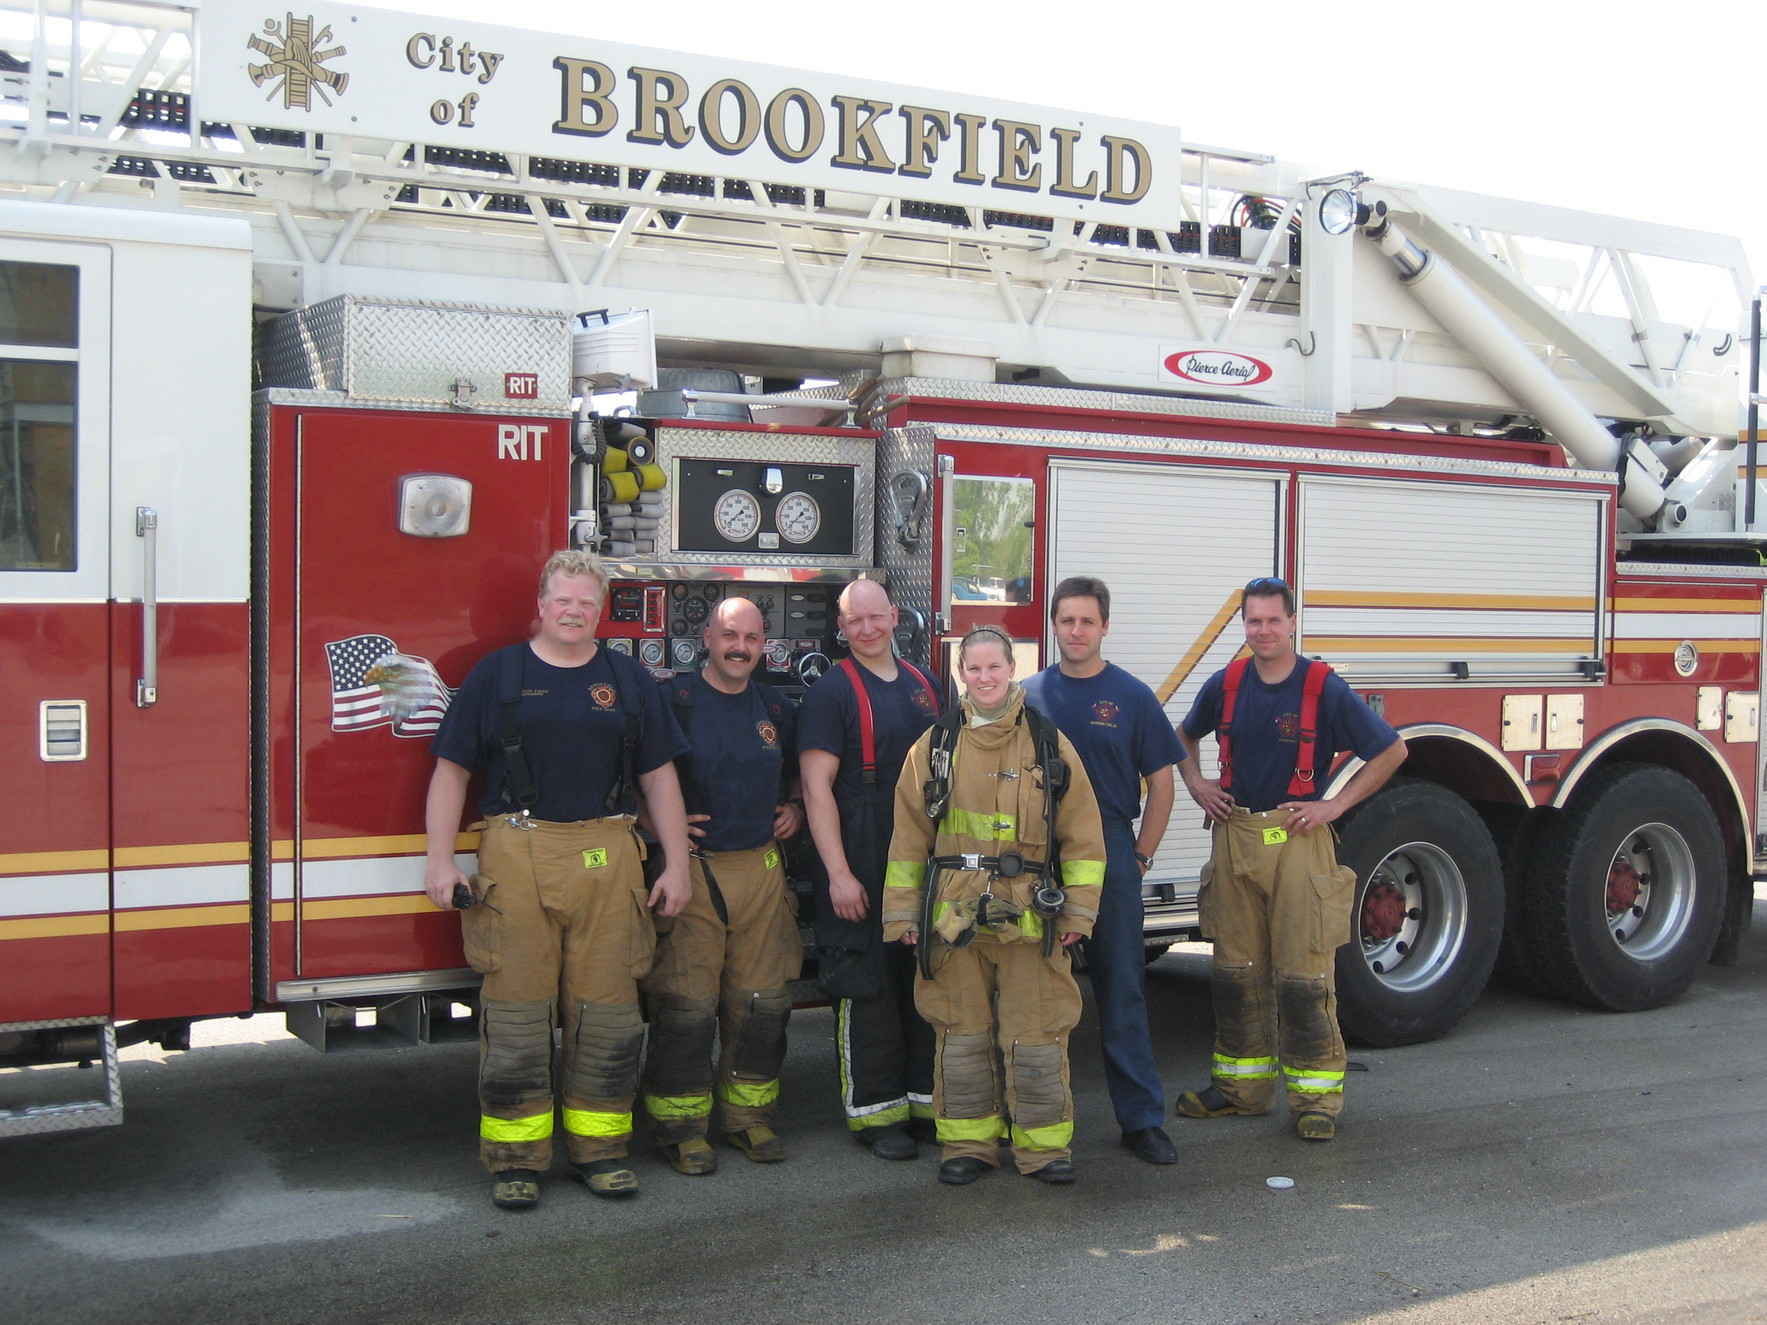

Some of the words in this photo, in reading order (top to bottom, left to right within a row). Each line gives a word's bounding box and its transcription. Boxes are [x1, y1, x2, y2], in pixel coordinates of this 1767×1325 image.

[406, 32, 504, 82] City
[430, 92, 480, 128] of
[552, 55, 1153, 205] BROOKFIELD
[510, 376, 535, 395] RIT
[1185, 355, 1218, 376] Pierce
[1221, 360, 1256, 381] Aerial
[498, 424, 549, 461] RIT
